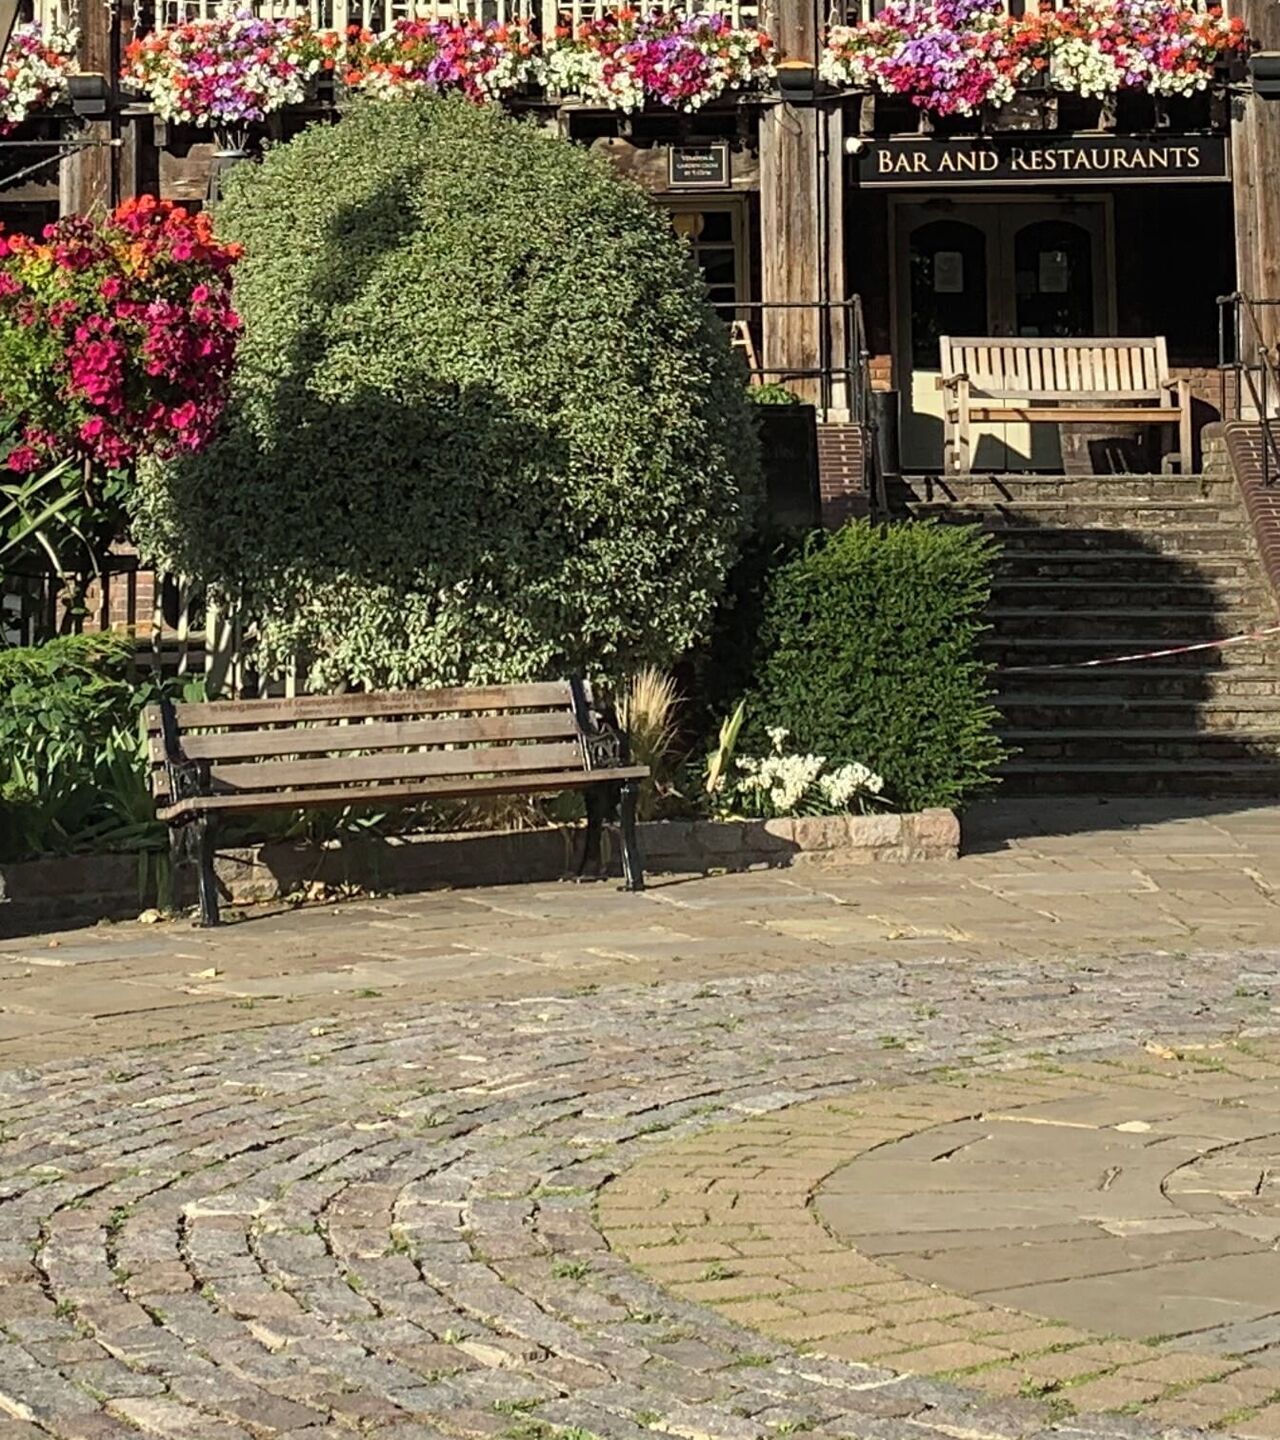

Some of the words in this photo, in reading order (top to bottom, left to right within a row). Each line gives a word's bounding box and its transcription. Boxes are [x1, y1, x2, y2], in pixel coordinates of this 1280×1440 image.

[878, 149, 931, 173] BAR
[937, 151, 999, 172] AND
[1011, 147, 1201, 171] RESTAURANTS
